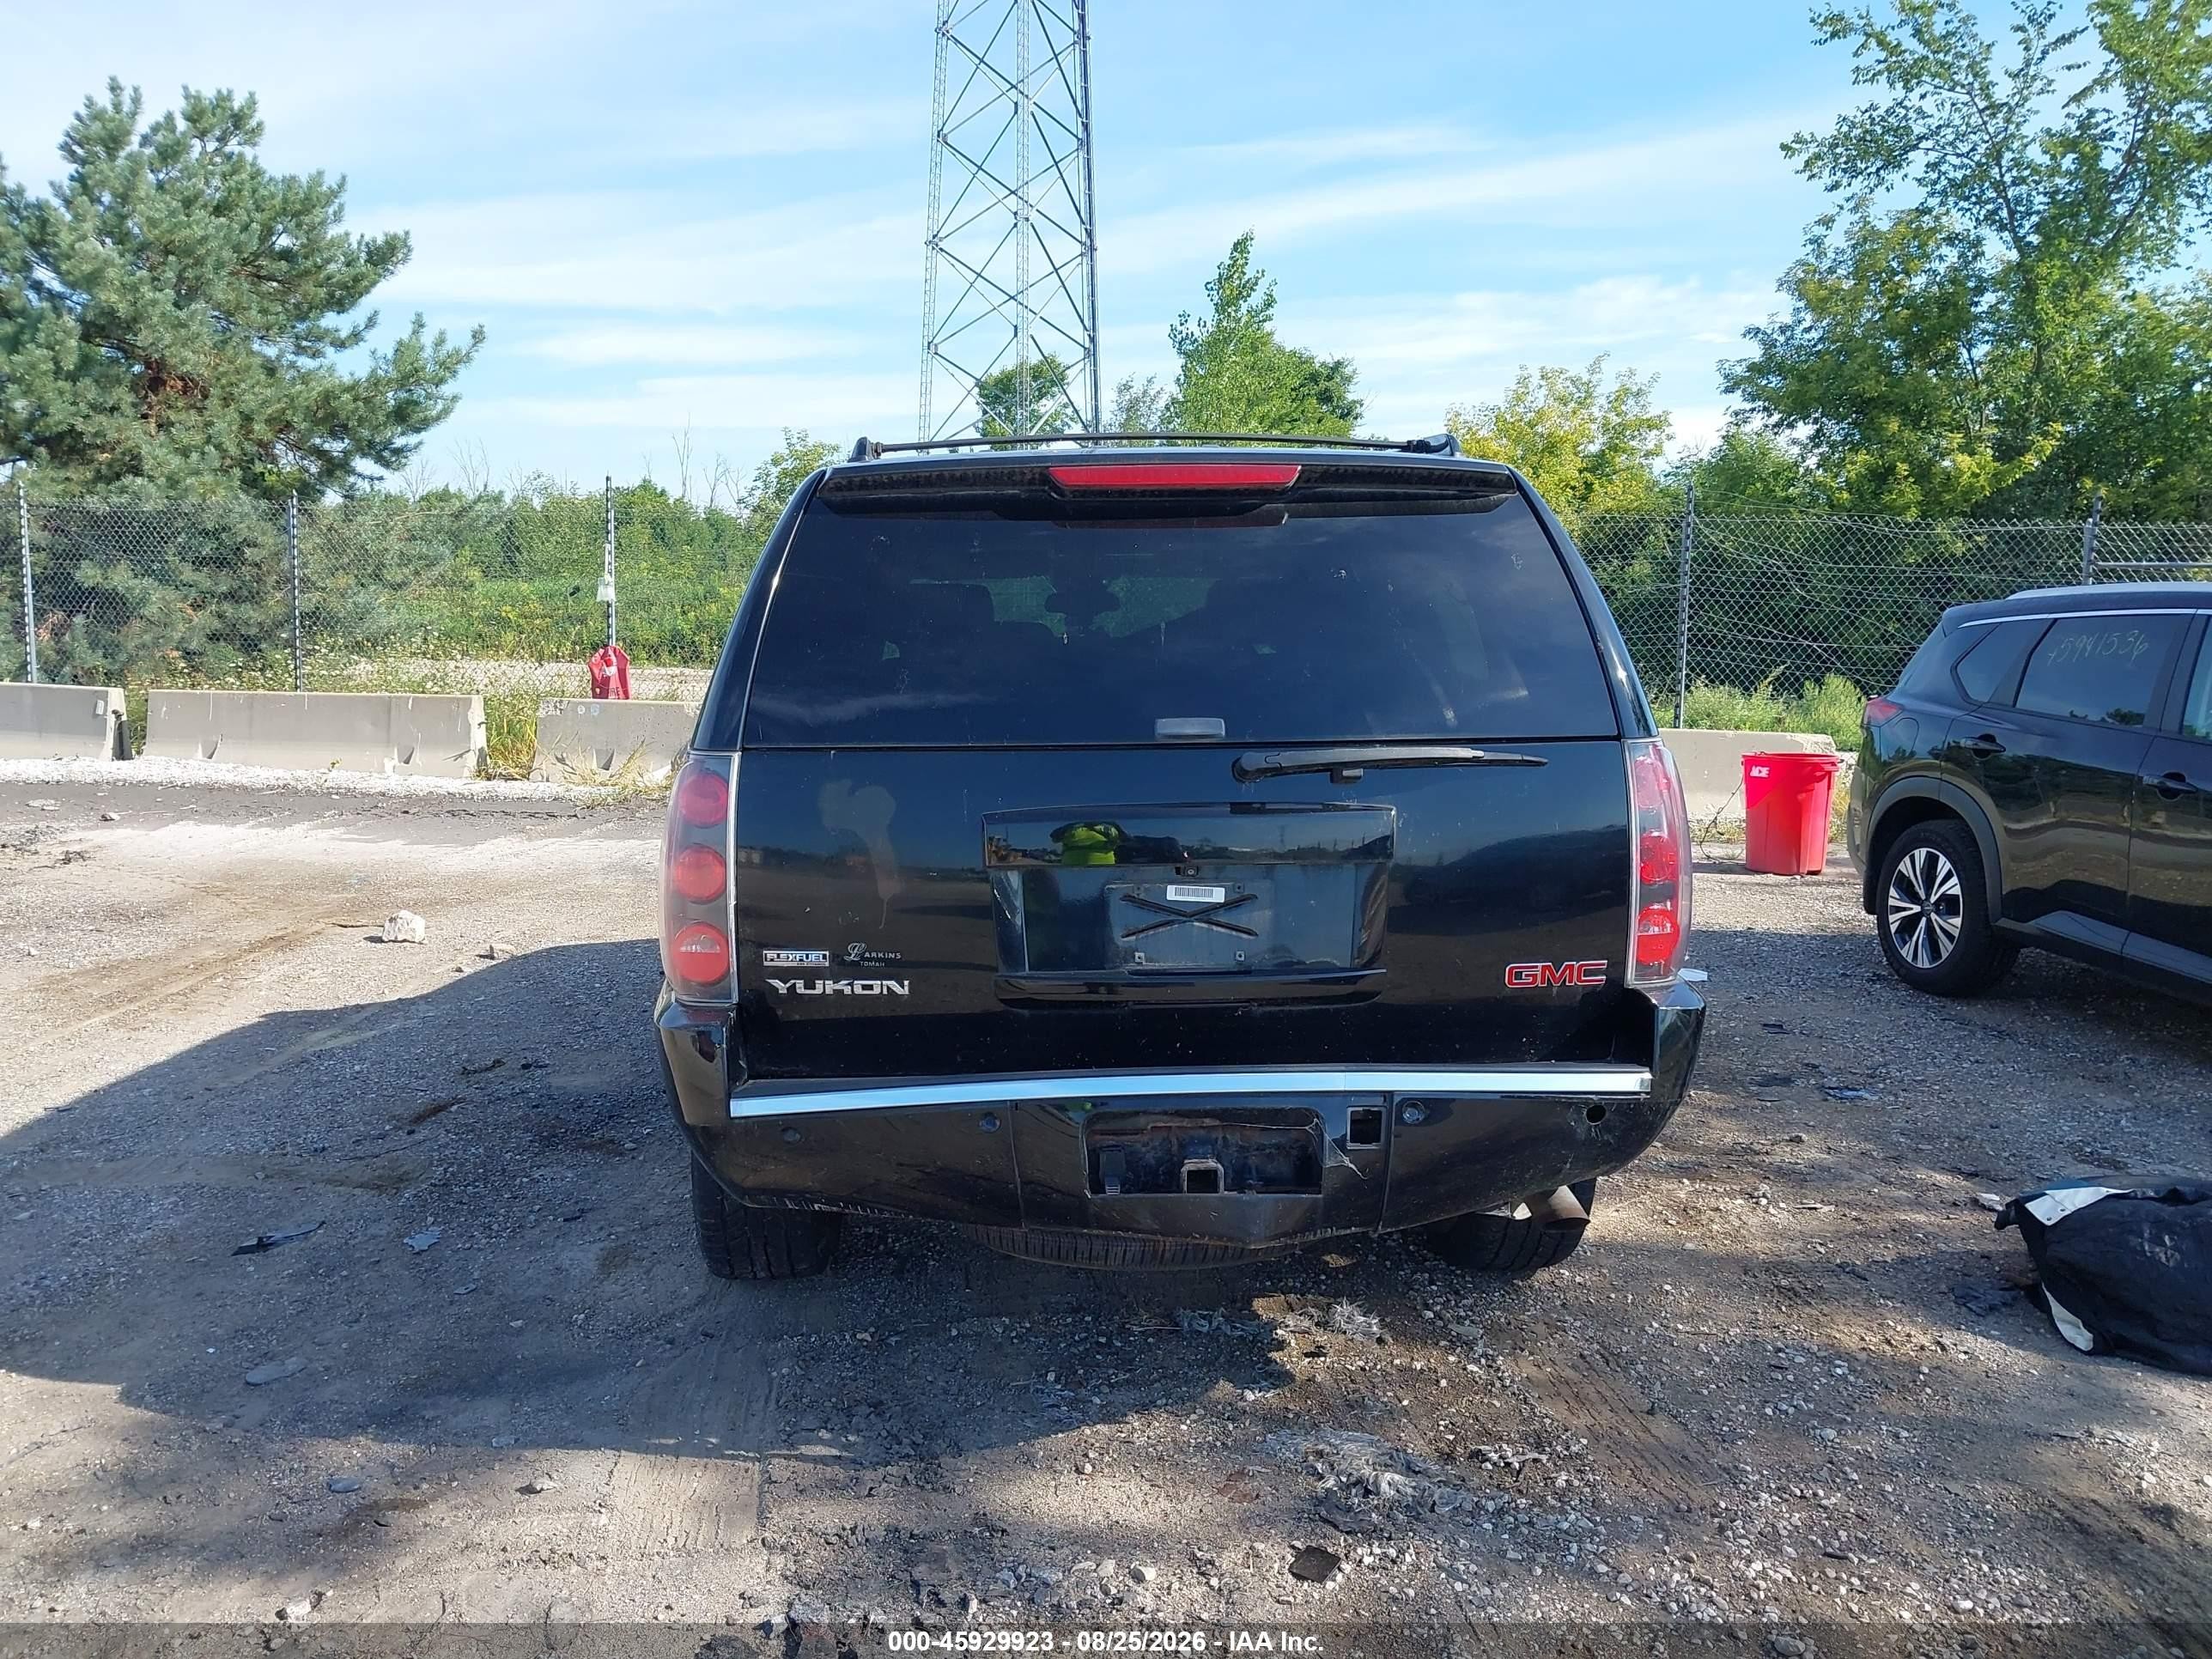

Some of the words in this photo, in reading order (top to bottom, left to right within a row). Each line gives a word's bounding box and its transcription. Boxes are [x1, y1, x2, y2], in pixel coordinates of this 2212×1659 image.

[1749, 764, 1770, 777] ACE
[767, 953, 826, 962] FLEXFUEL
[843, 942, 902, 961] LARKINS
[1504, 960, 1608, 988] GMC
[764, 979, 911, 995] YUKON
